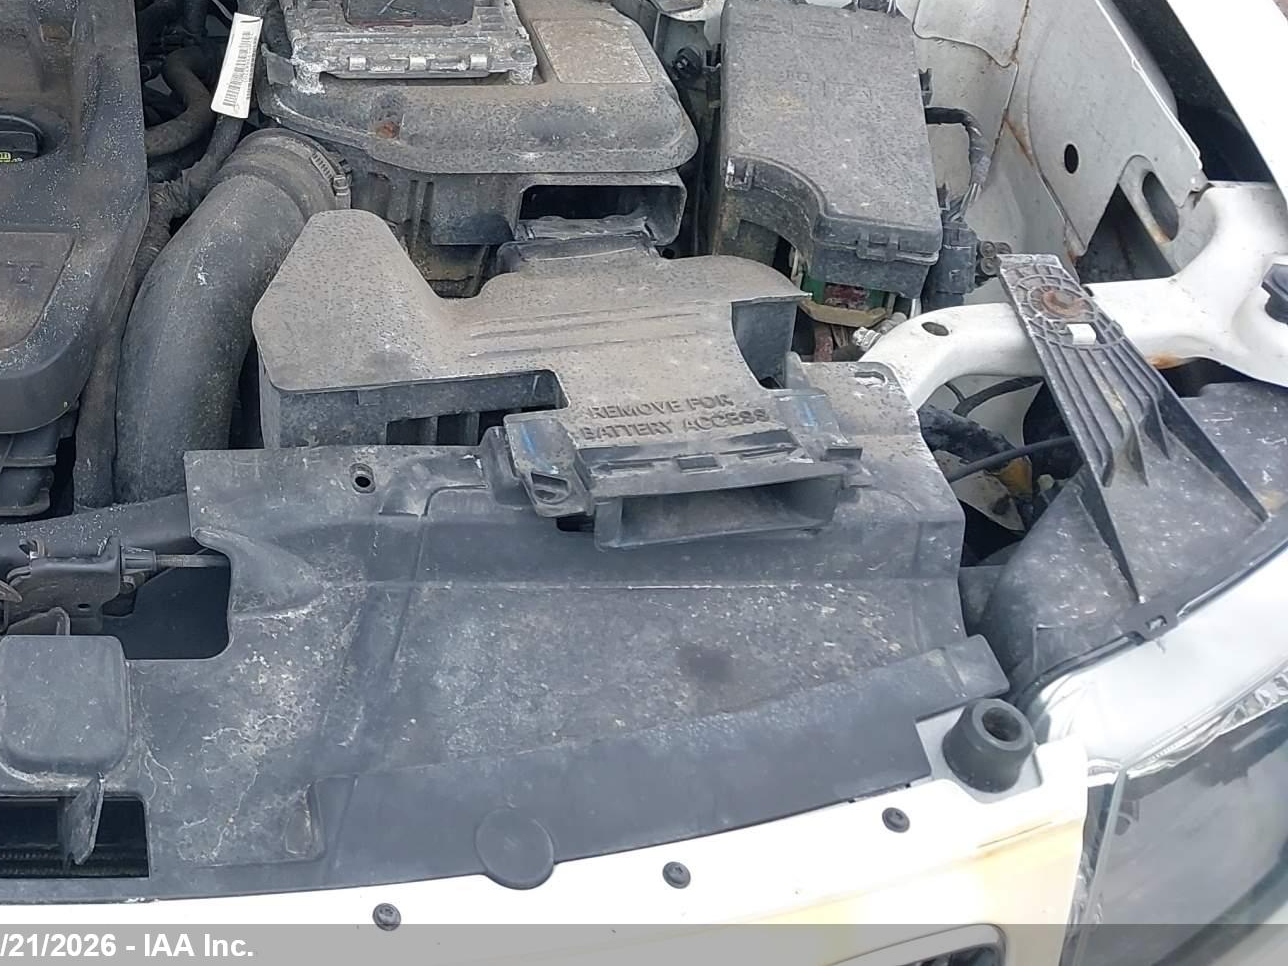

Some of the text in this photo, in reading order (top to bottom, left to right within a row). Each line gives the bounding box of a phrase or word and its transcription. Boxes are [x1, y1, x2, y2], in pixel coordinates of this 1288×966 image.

[588, 393, 734, 420] REMOVE FOR
[580, 409, 769, 441] BATTERY ACCESS
